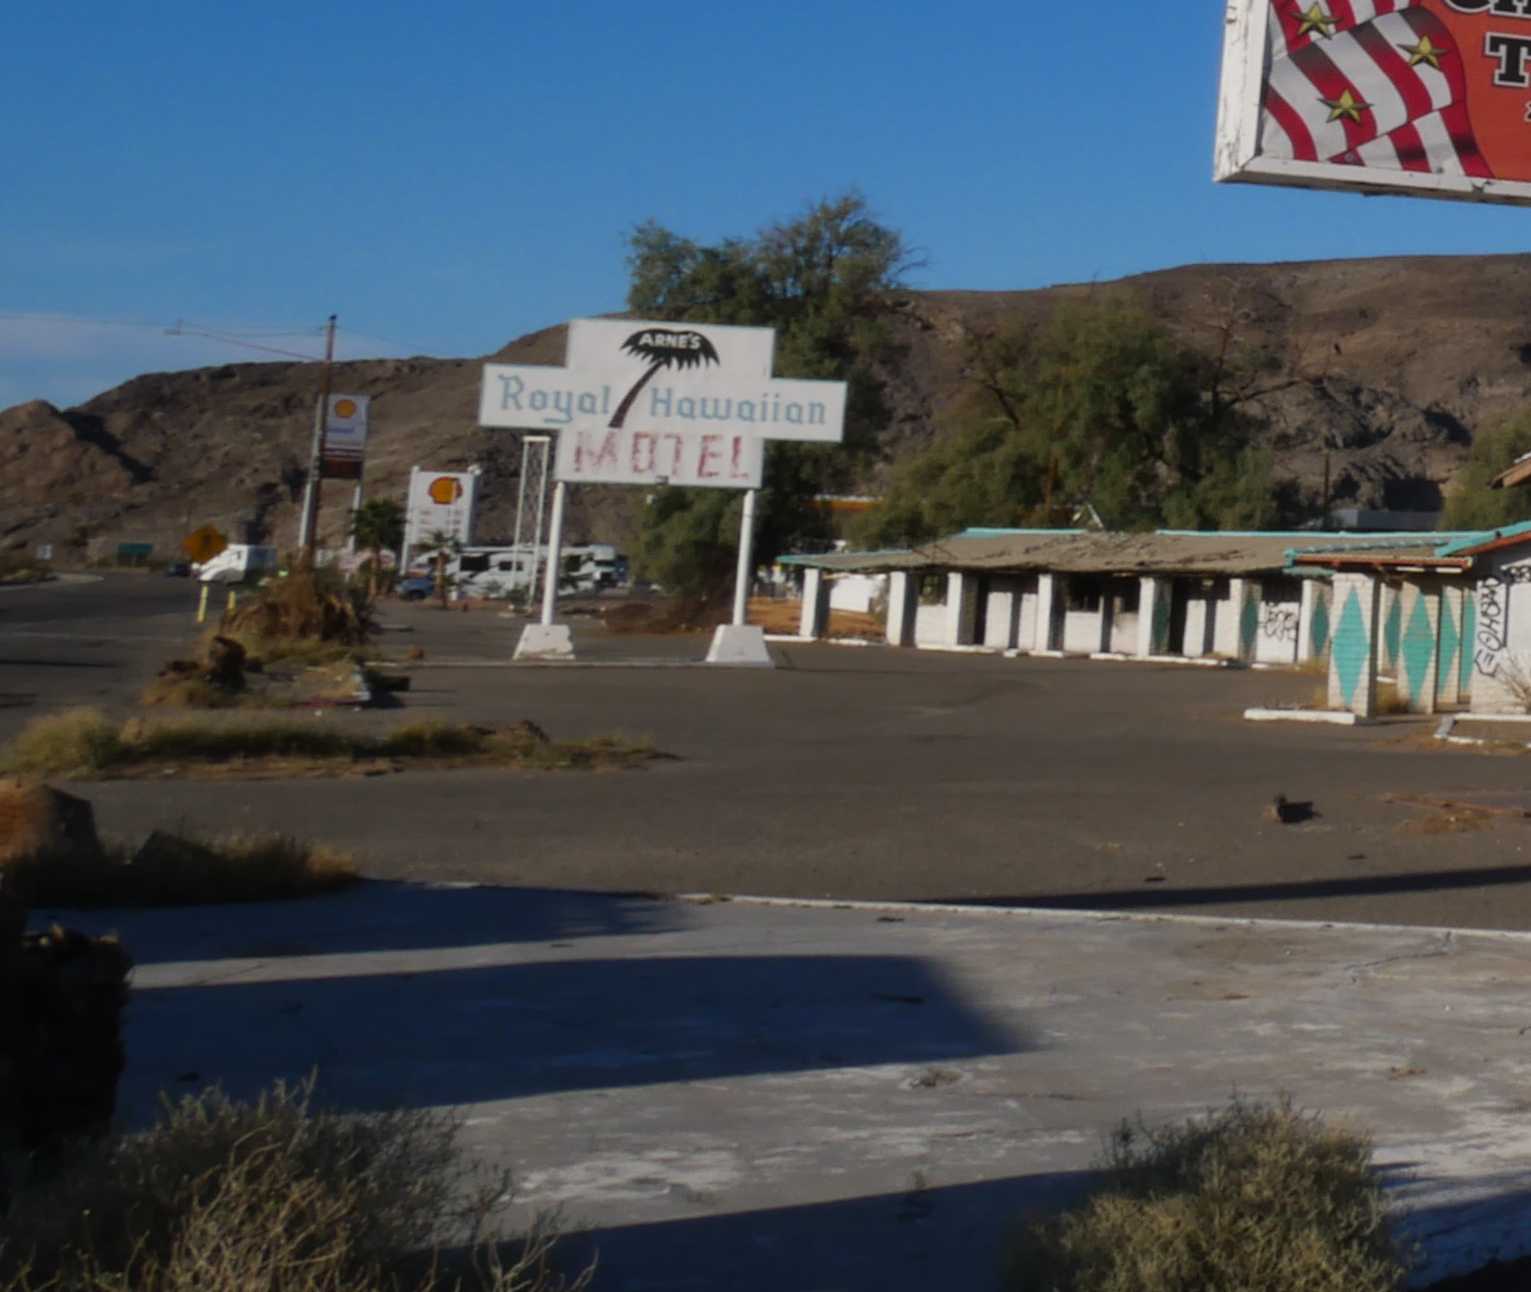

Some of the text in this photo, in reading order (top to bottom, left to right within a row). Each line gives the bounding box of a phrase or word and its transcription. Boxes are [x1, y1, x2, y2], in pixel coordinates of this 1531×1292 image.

[638, 331, 702, 351] ARNE'S
[497, 373, 827, 426] Royal Hawaiian
[572, 428, 750, 480] MOTEL
